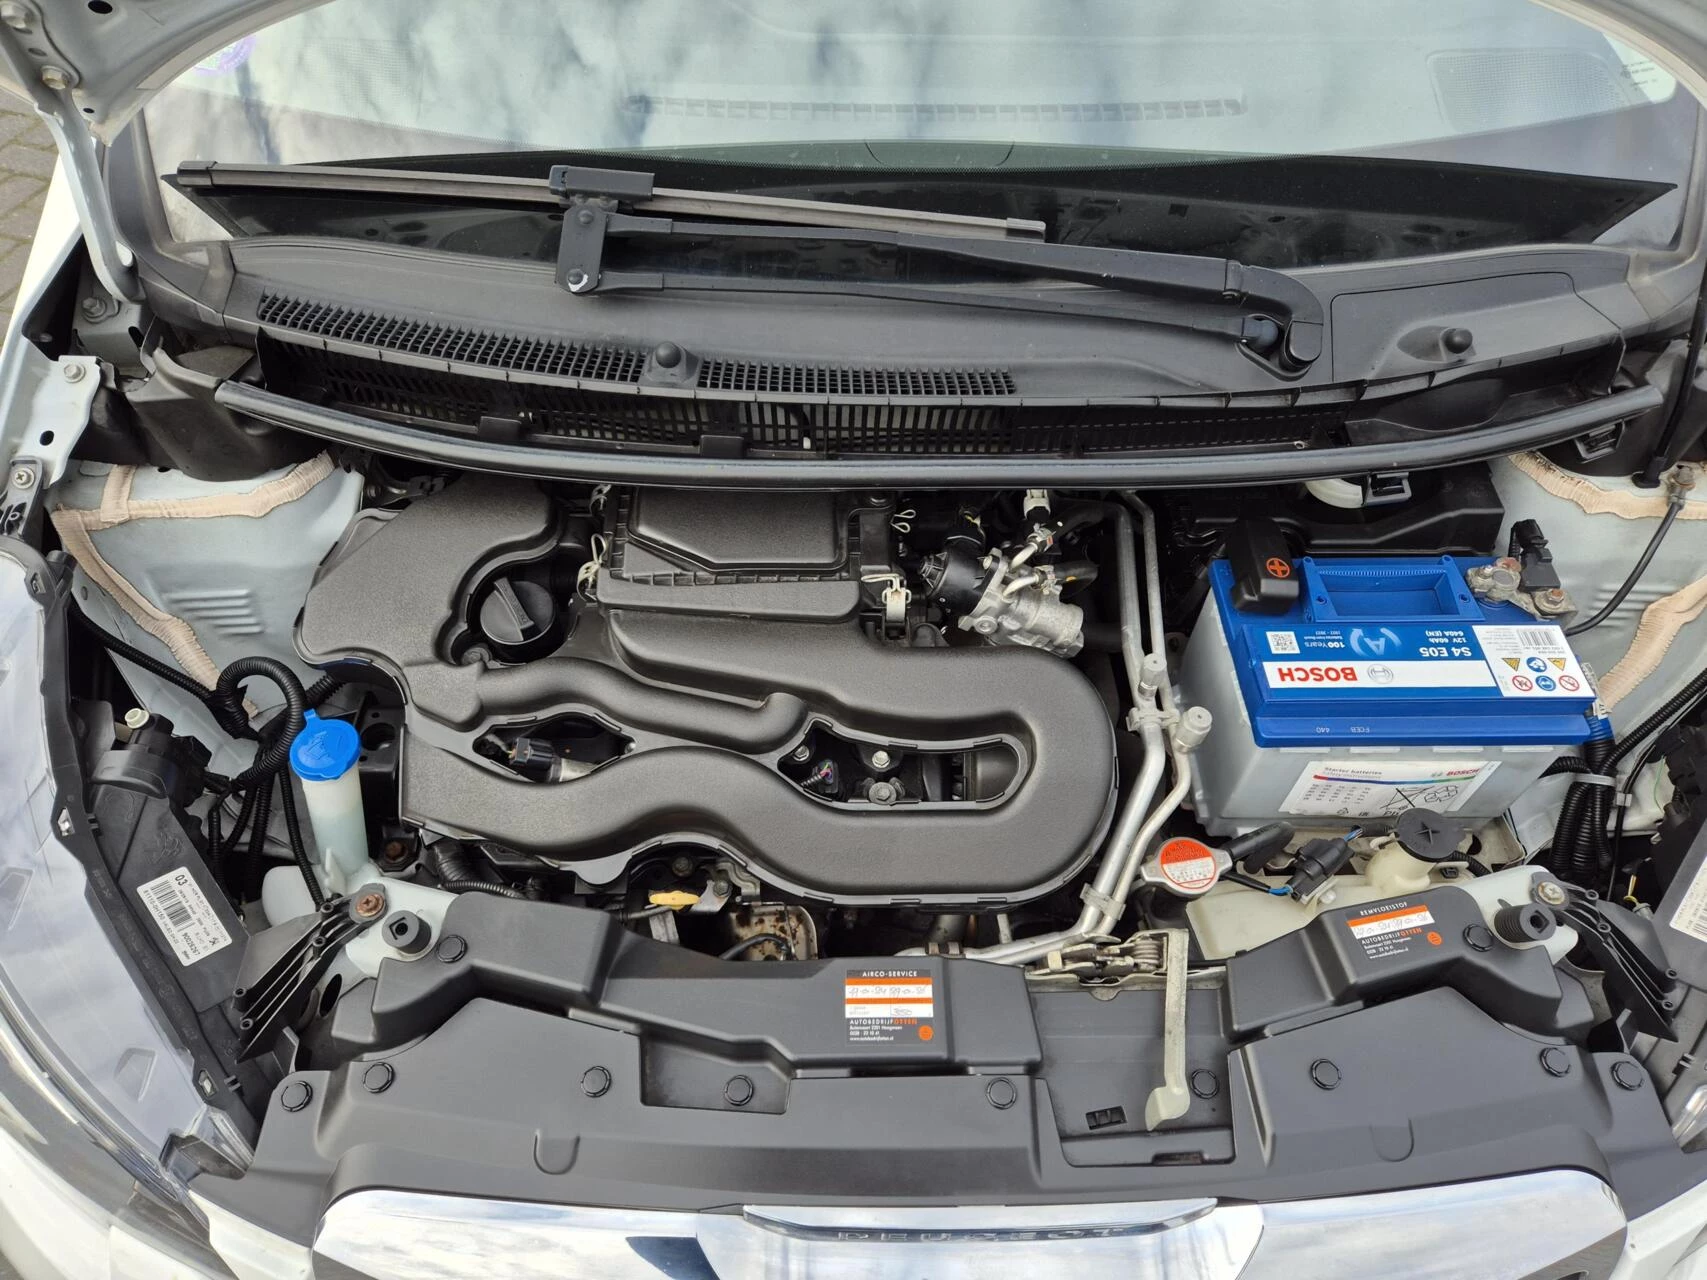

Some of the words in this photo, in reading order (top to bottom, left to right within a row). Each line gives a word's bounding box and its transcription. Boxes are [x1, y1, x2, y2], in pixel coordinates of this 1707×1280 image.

[1328, 641, 1346, 649] 100
[1419, 646, 1448, 657] E05
[1451, 646, 1472, 657] S4
[1277, 667, 1358, 682] BOSCH
[1446, 767, 1480, 776] BOSCH
[174, 874, 188, 886] 03
[1360, 901, 1408, 916] REMVLOEISTOF
[838, 1228, 1124, 1243] PEUGEOT
